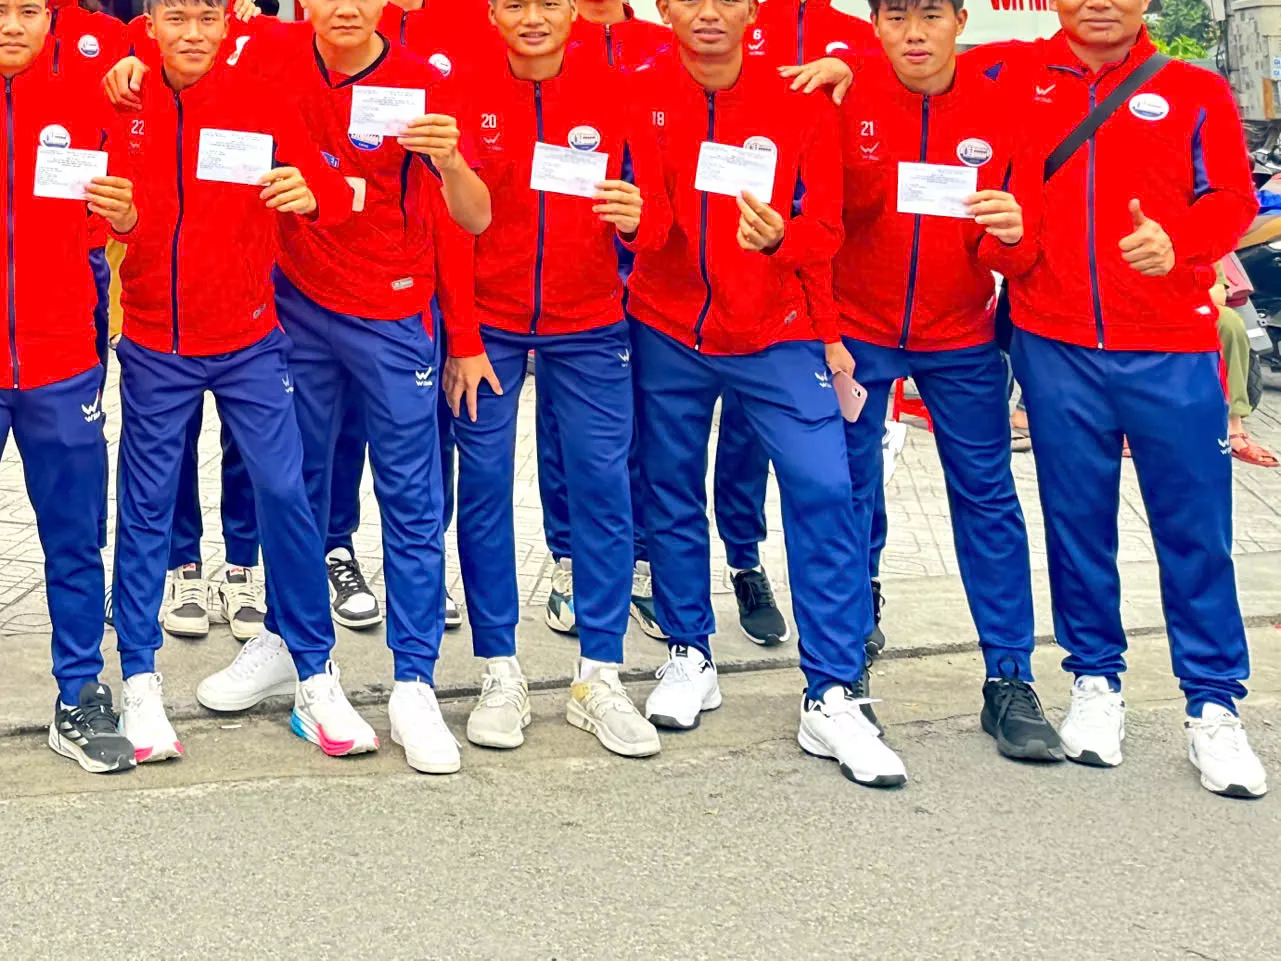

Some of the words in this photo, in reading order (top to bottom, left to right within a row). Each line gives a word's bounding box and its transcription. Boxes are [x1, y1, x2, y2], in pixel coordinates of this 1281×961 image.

[131, 119, 145, 135] 22
[482, 114, 496, 128] 20
[652, 111, 665, 127] 18
[860, 120, 874, 136] 21
